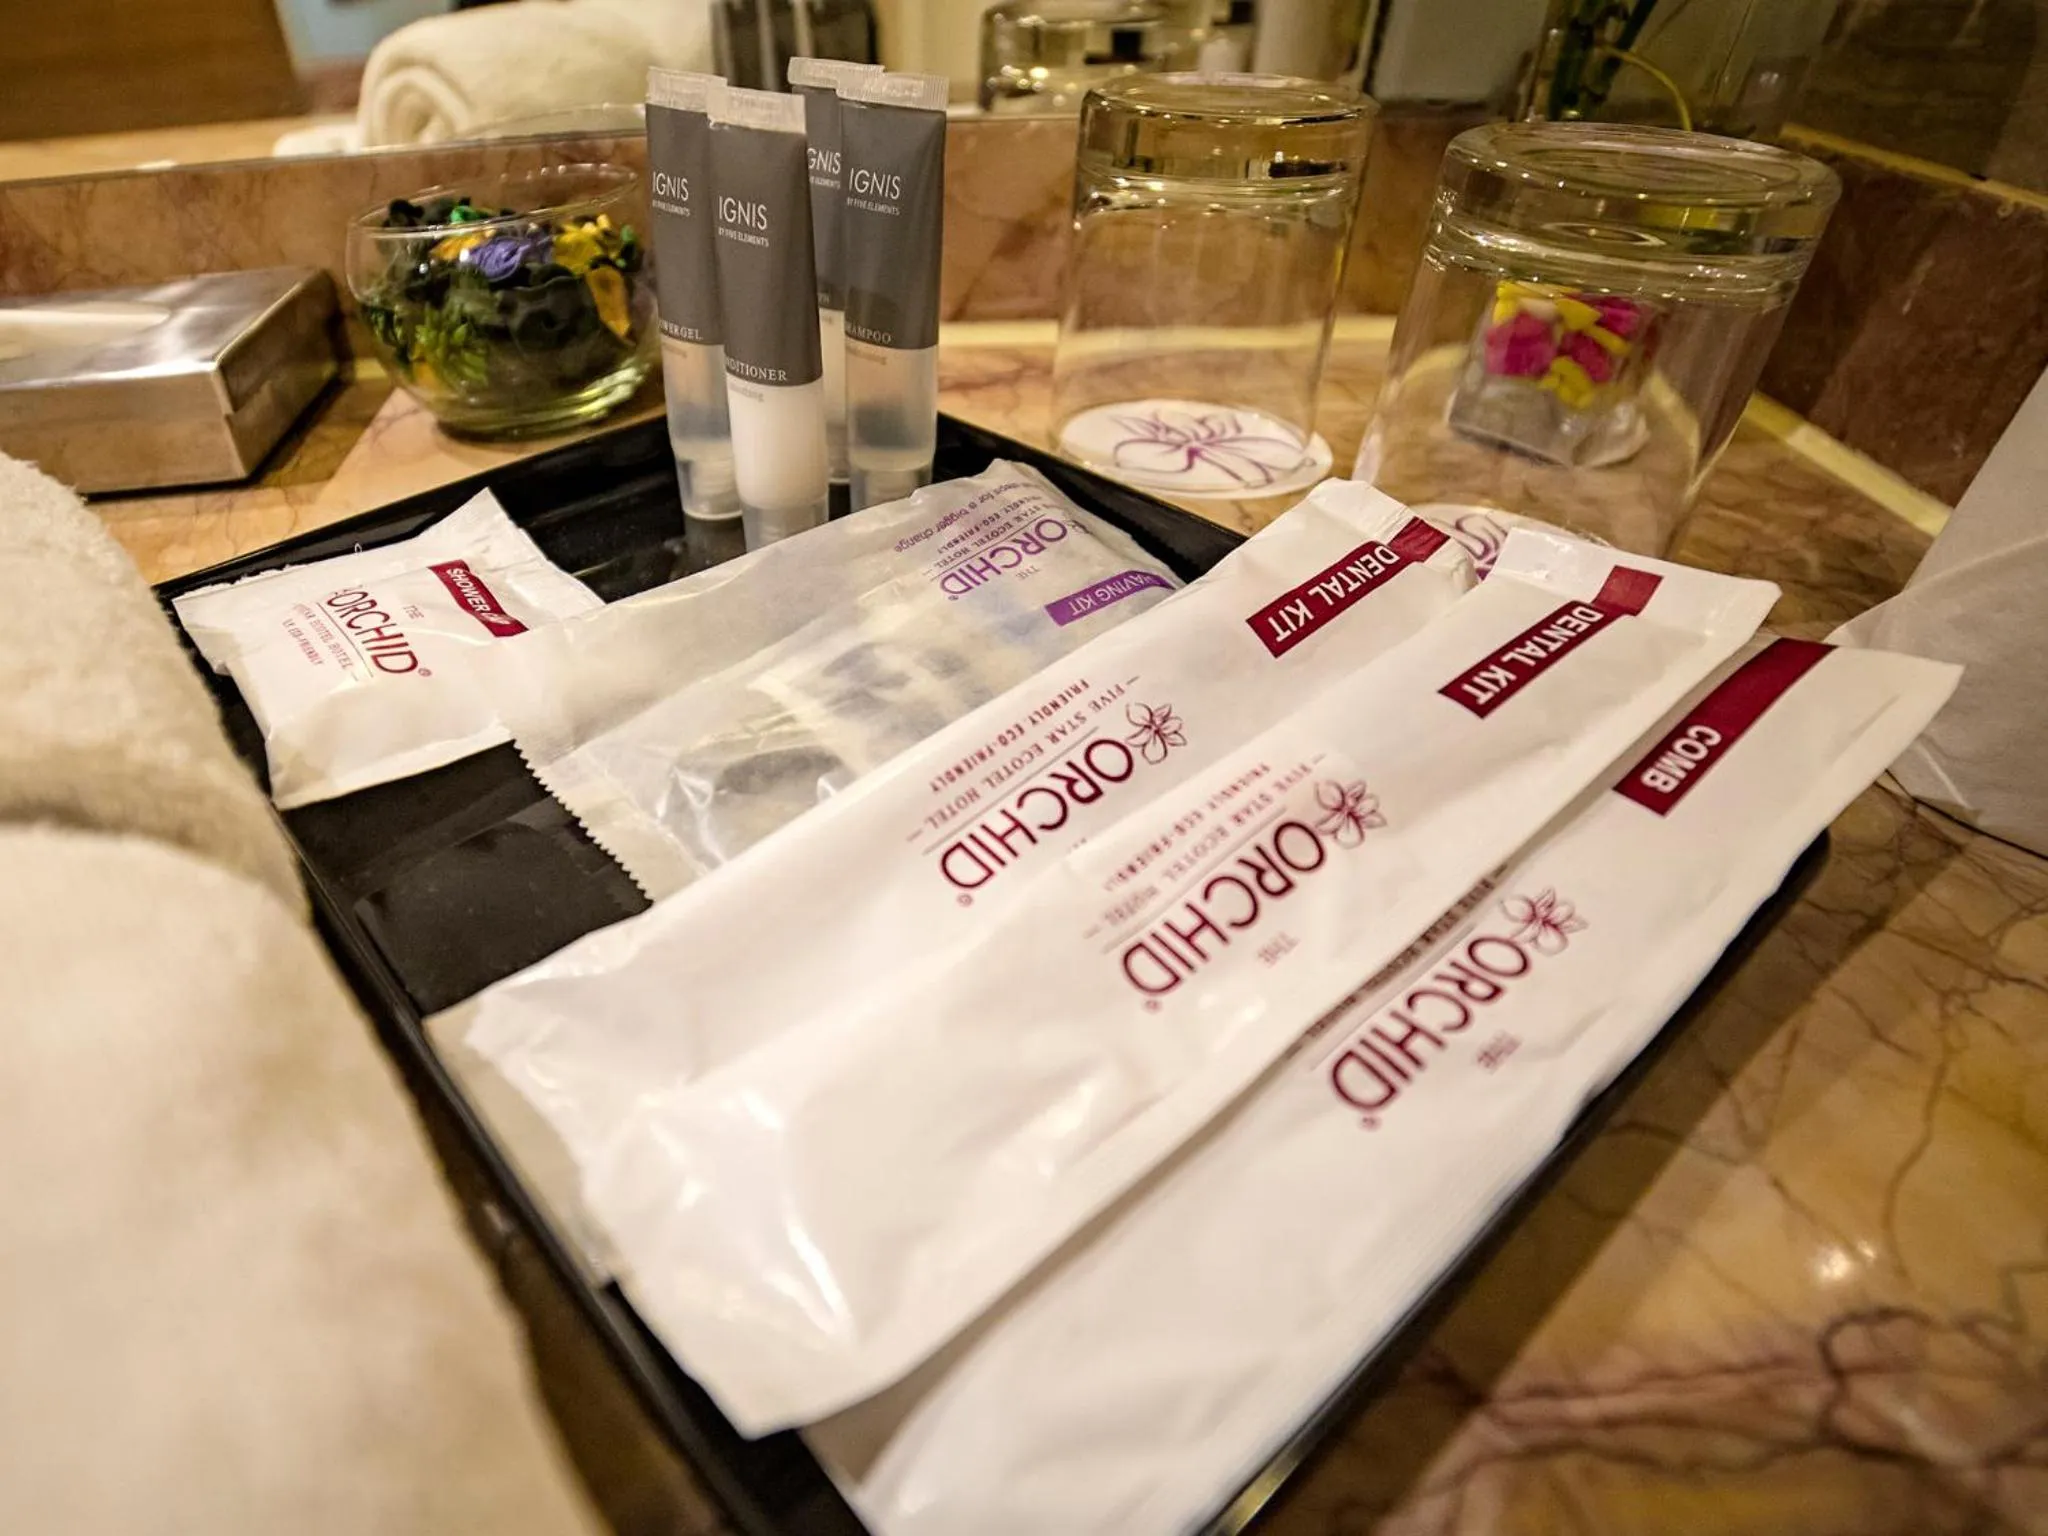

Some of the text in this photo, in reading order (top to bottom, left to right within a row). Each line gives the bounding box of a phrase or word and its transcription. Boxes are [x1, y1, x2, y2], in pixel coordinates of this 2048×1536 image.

[806, 147, 841, 174] GNIS
[652, 171, 689, 201] IGNIS
[849, 167, 901, 200] IGNIS
[719, 196, 767, 230] IGNIS
[936, 508, 970, 533] bigger
[894, 528, 934, 553] change
[934, 547, 971, 568] HOTEL
[446, 568, 491, 612] SHOWER
[1068, 594, 1097, 616] KIT
[1266, 544, 1400, 643] DENTAL KIT
[1461, 603, 1605, 706] DENTAL KIT
[926, 683, 1126, 829] FIVE STAR ECOTEL HOTEL
[1640, 724, 1722, 794] COMB
